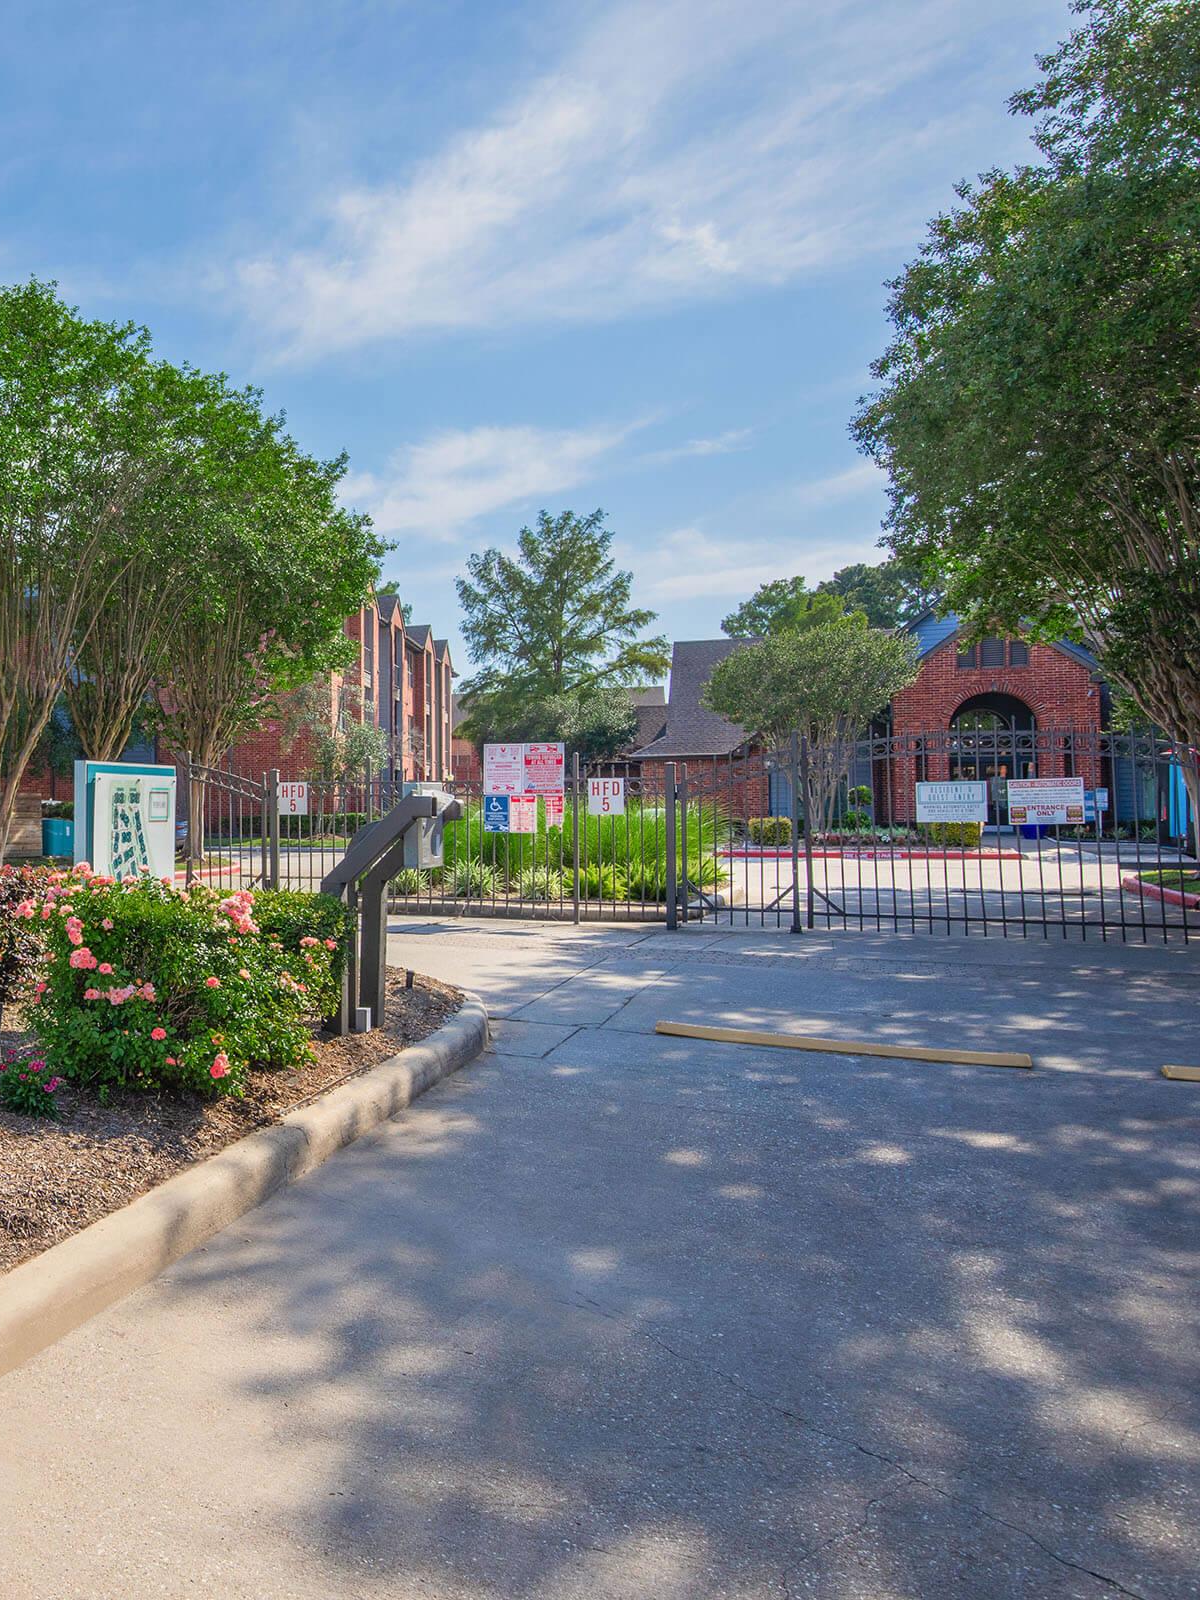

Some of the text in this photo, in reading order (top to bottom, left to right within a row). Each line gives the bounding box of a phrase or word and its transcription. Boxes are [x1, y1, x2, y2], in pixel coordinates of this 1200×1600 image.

[282, 785, 304, 798] HFD
[592, 781, 620, 796] HFD
[930, 786, 962, 794] RESIDENT
[954, 793, 975, 801] ENTRY
[290, 799, 296, 812] 5
[602, 797, 609, 811] 5
